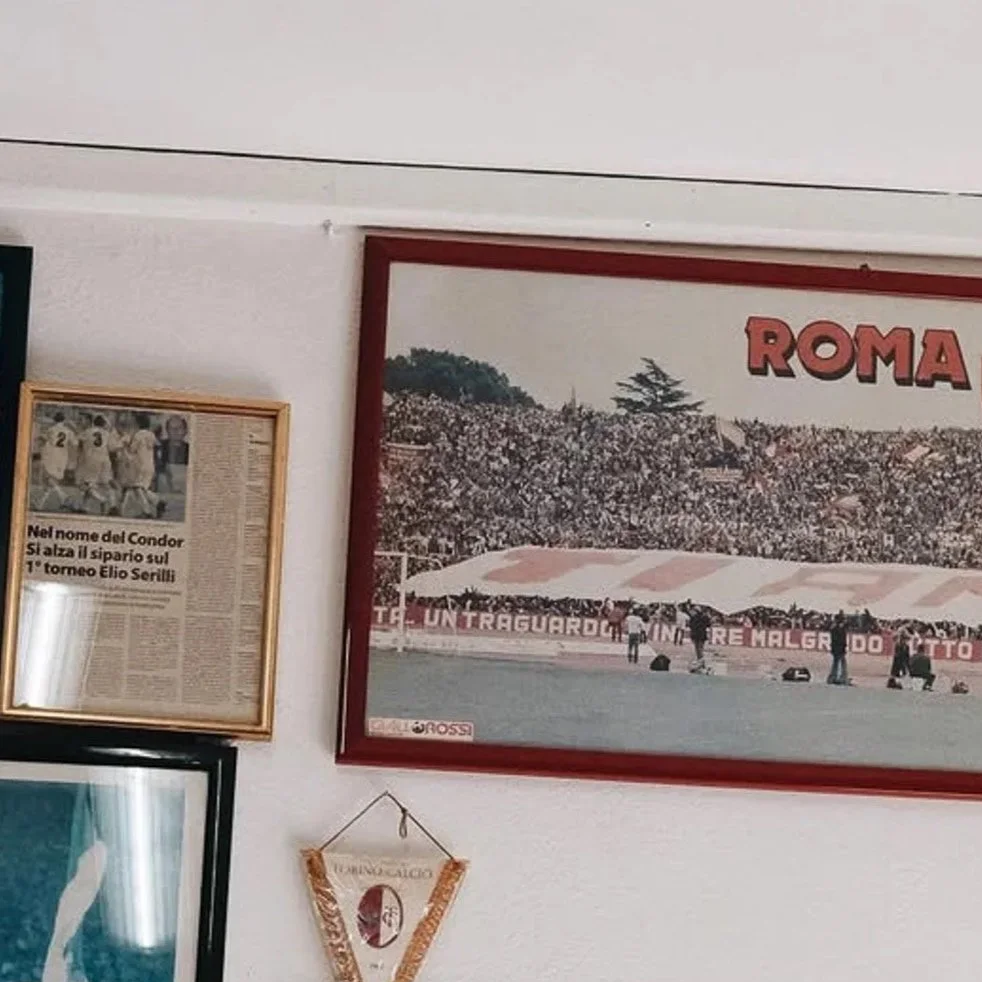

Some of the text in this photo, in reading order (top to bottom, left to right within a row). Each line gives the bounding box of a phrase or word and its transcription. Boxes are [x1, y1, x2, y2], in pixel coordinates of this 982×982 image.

[745, 316, 972, 390] ROMA
[56, 431, 67, 447] 2
[93, 431, 103, 447] 3
[27, 525, 185, 548] Nel nome del Condor
[26, 543, 169, 565] Si alza il sipario sul
[44, 563, 97, 577] torneo
[100, 565, 128, 580] Elio
[132, 568, 176, 583] Serilli
[424, 608, 457, 628] UN
[752, 628, 882, 653] MALGRDO
